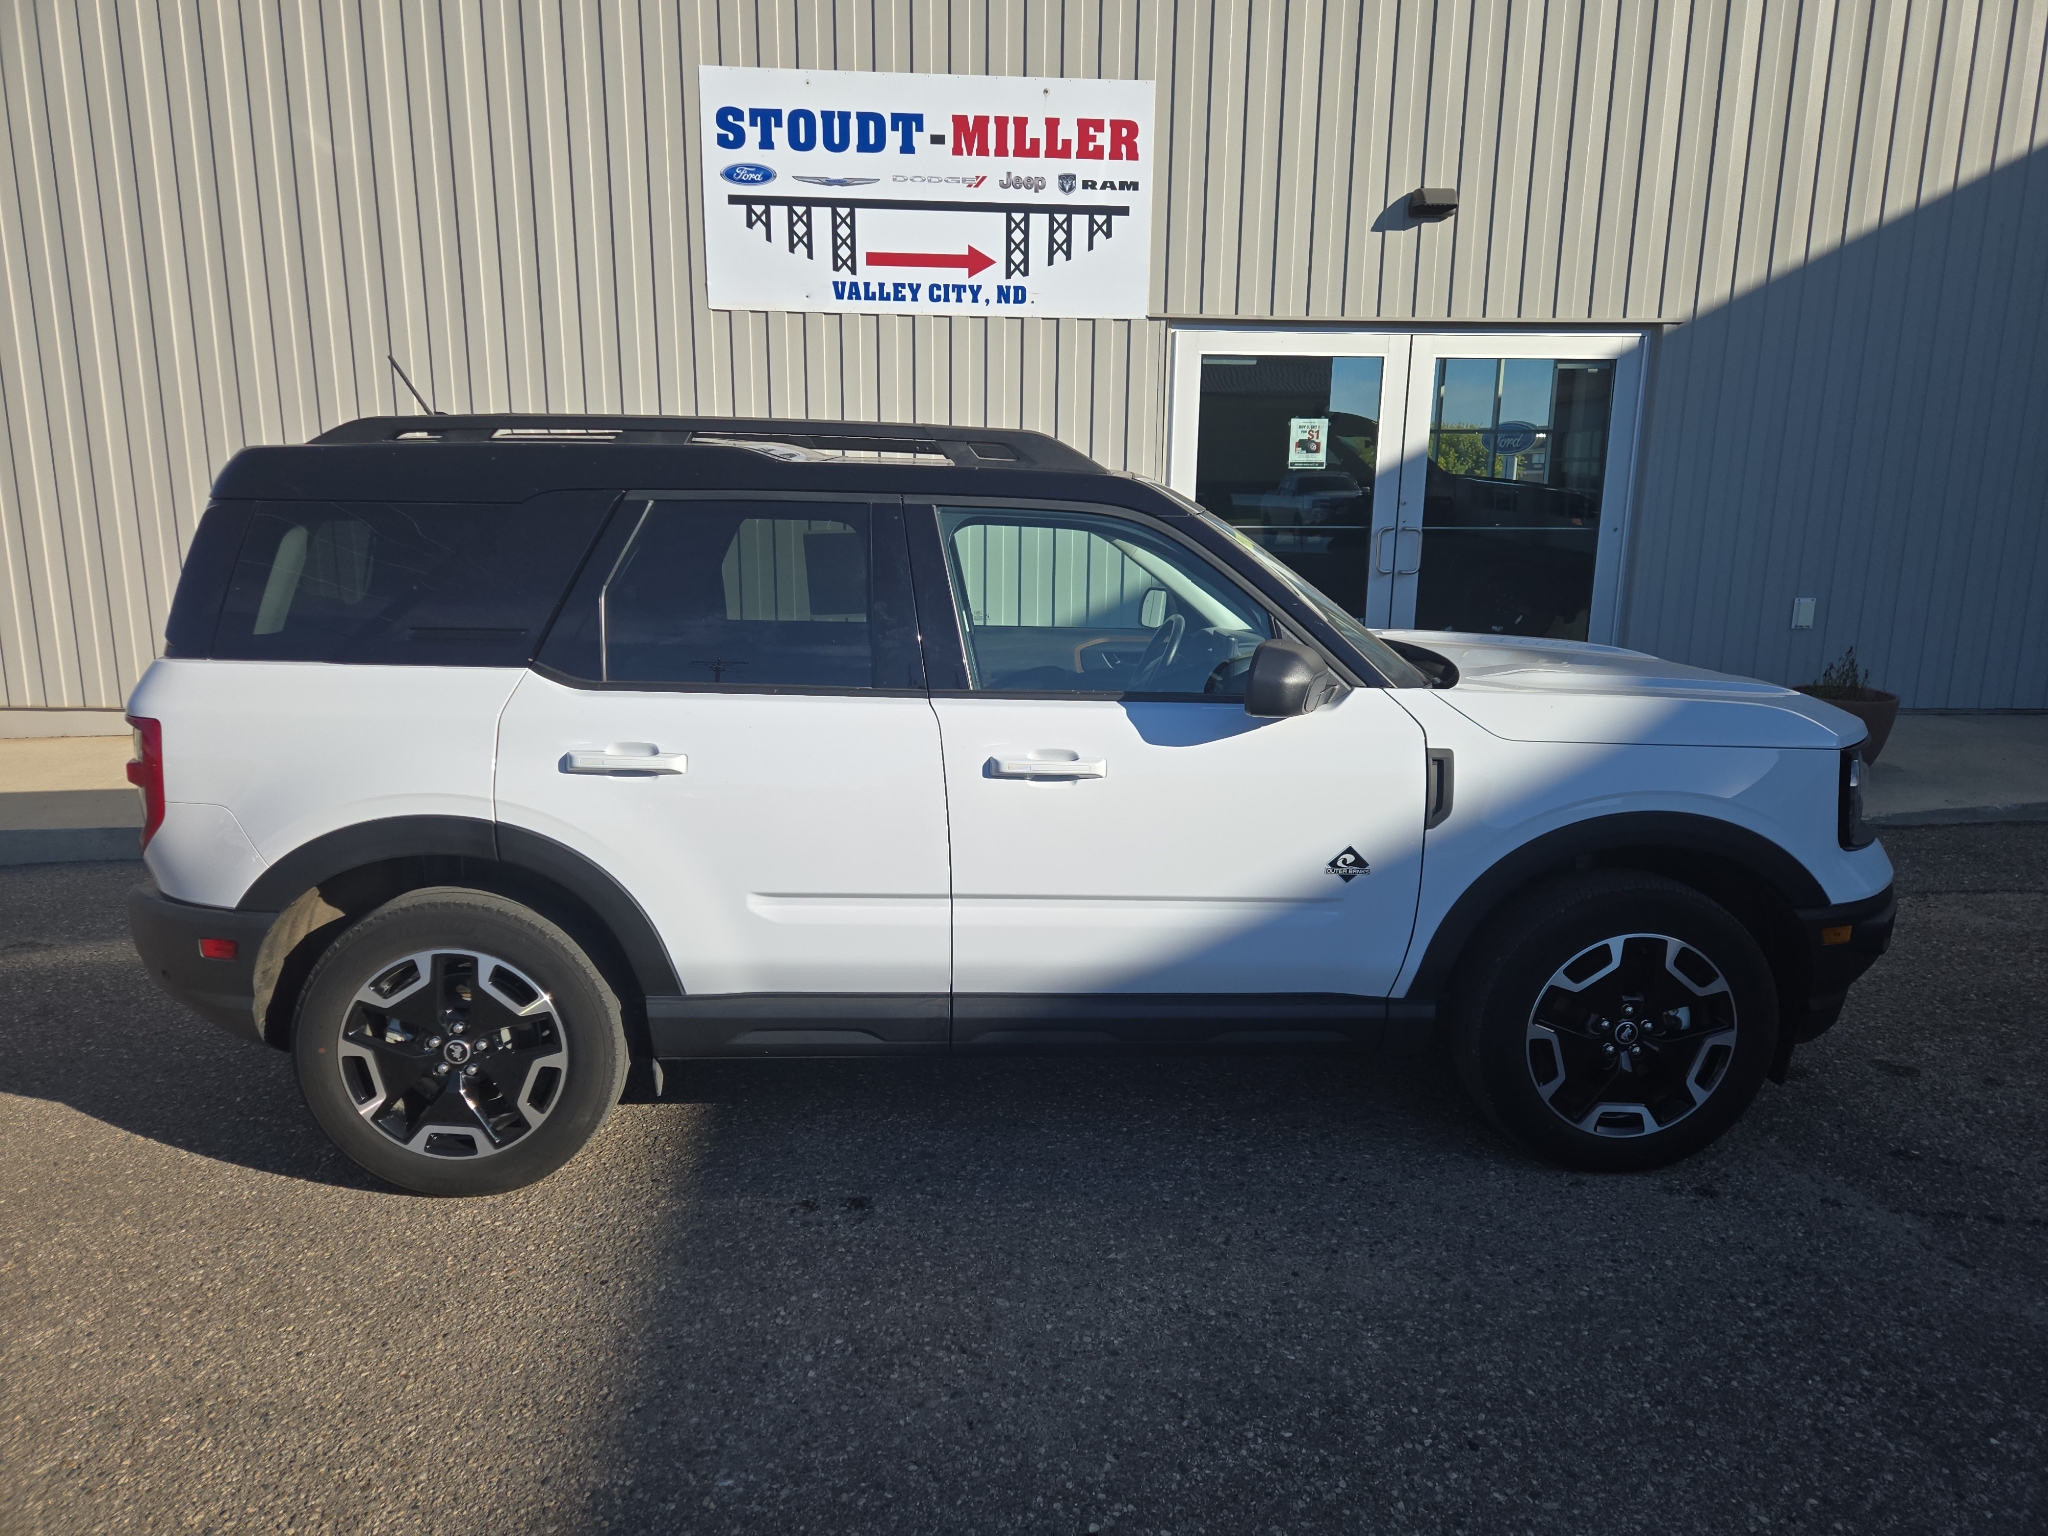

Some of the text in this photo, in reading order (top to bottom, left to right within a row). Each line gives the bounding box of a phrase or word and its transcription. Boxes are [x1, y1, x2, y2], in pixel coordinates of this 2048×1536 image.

[715, 106, 1140, 161] STOUDT-MILLER
[733, 166, 764, 181] Ford
[892, 174, 977, 185] DODGE
[999, 171, 1047, 193] Jeep
[1081, 179, 1140, 191] RAM
[832, 281, 1027, 306] VALLEY CITY, ND
[1308, 429, 1320, 440] $1
